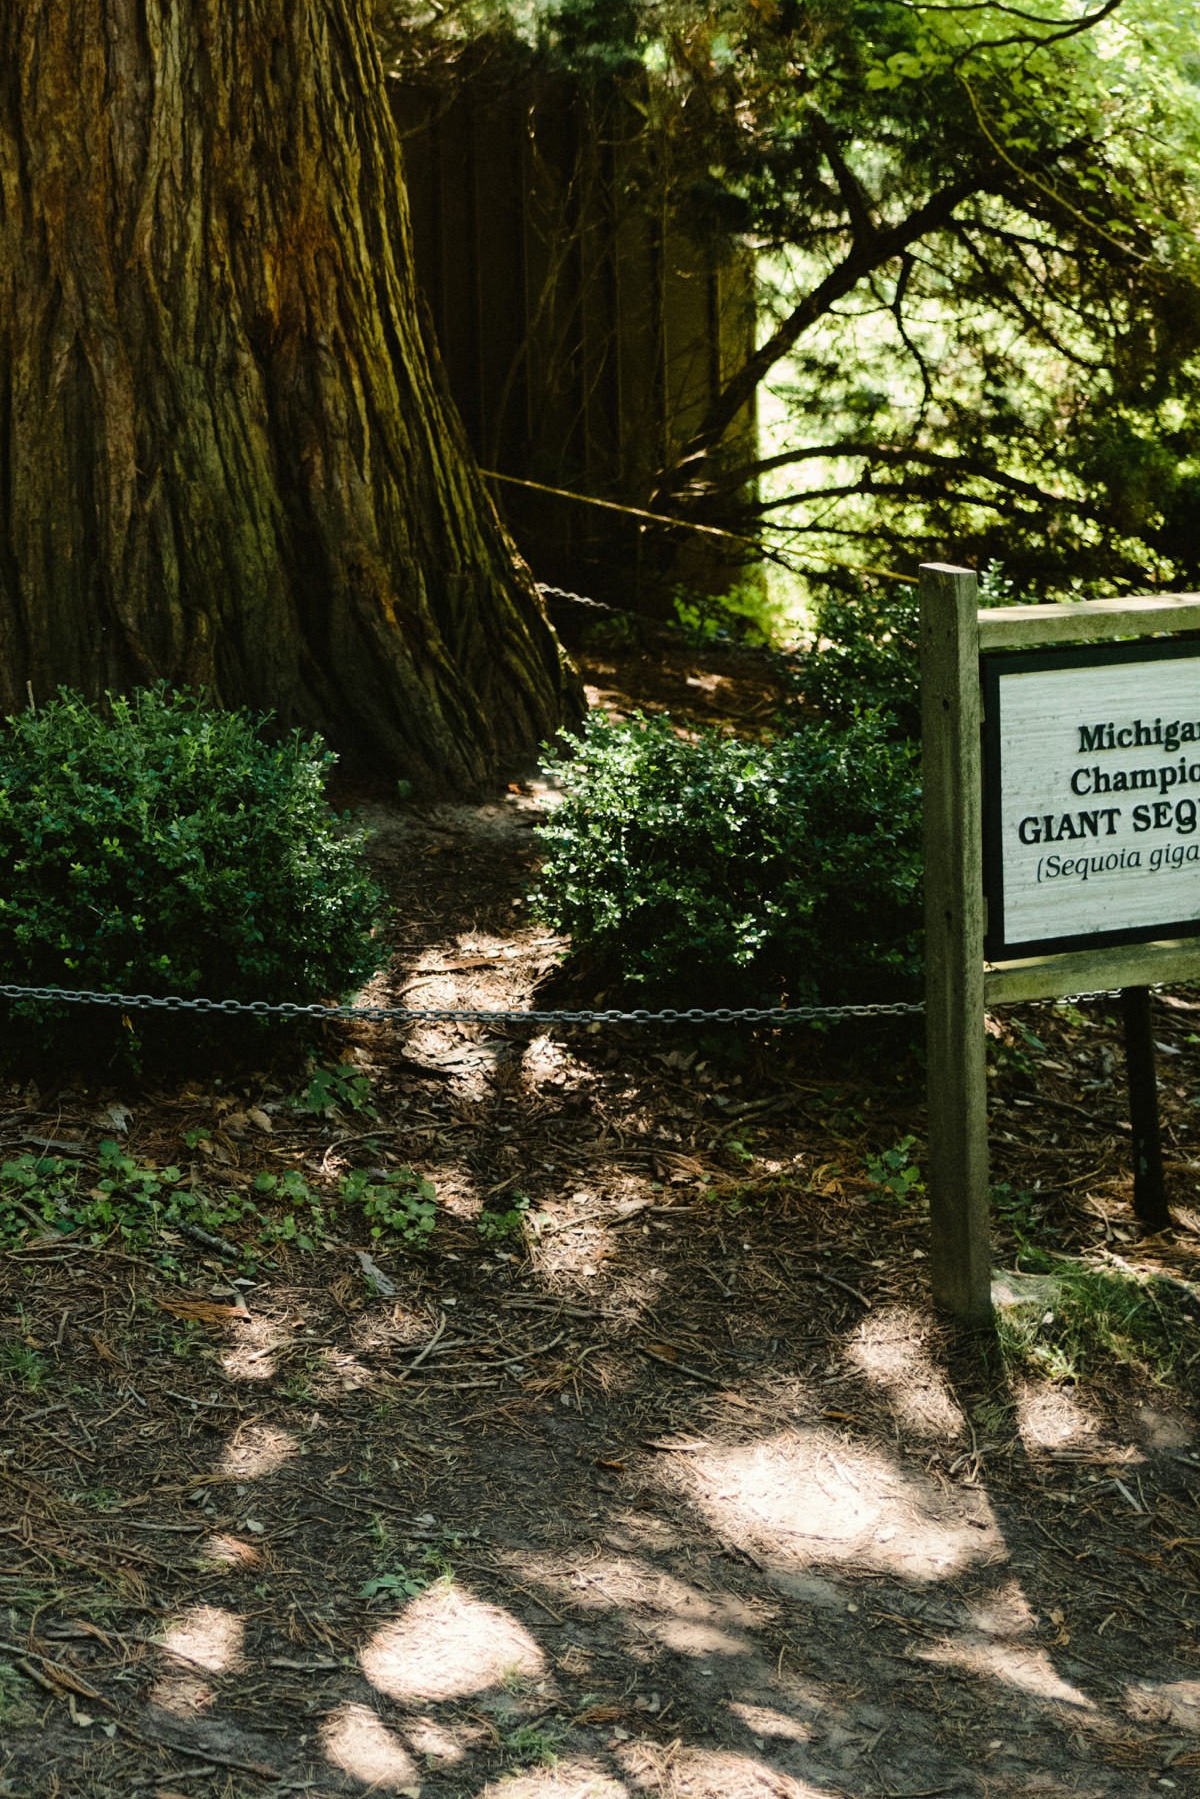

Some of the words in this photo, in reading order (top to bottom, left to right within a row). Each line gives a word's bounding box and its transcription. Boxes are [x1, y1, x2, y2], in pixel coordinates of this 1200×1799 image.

[1077, 717, 1200, 753] Michiga
[1070, 756, 1200, 796] Champio
[1018, 808, 1122, 845] GIANT
[1132, 798, 1200, 835] SEQ
[1037, 848, 1142, 883] (Sequoia
[1149, 843, 1200, 872] giga
